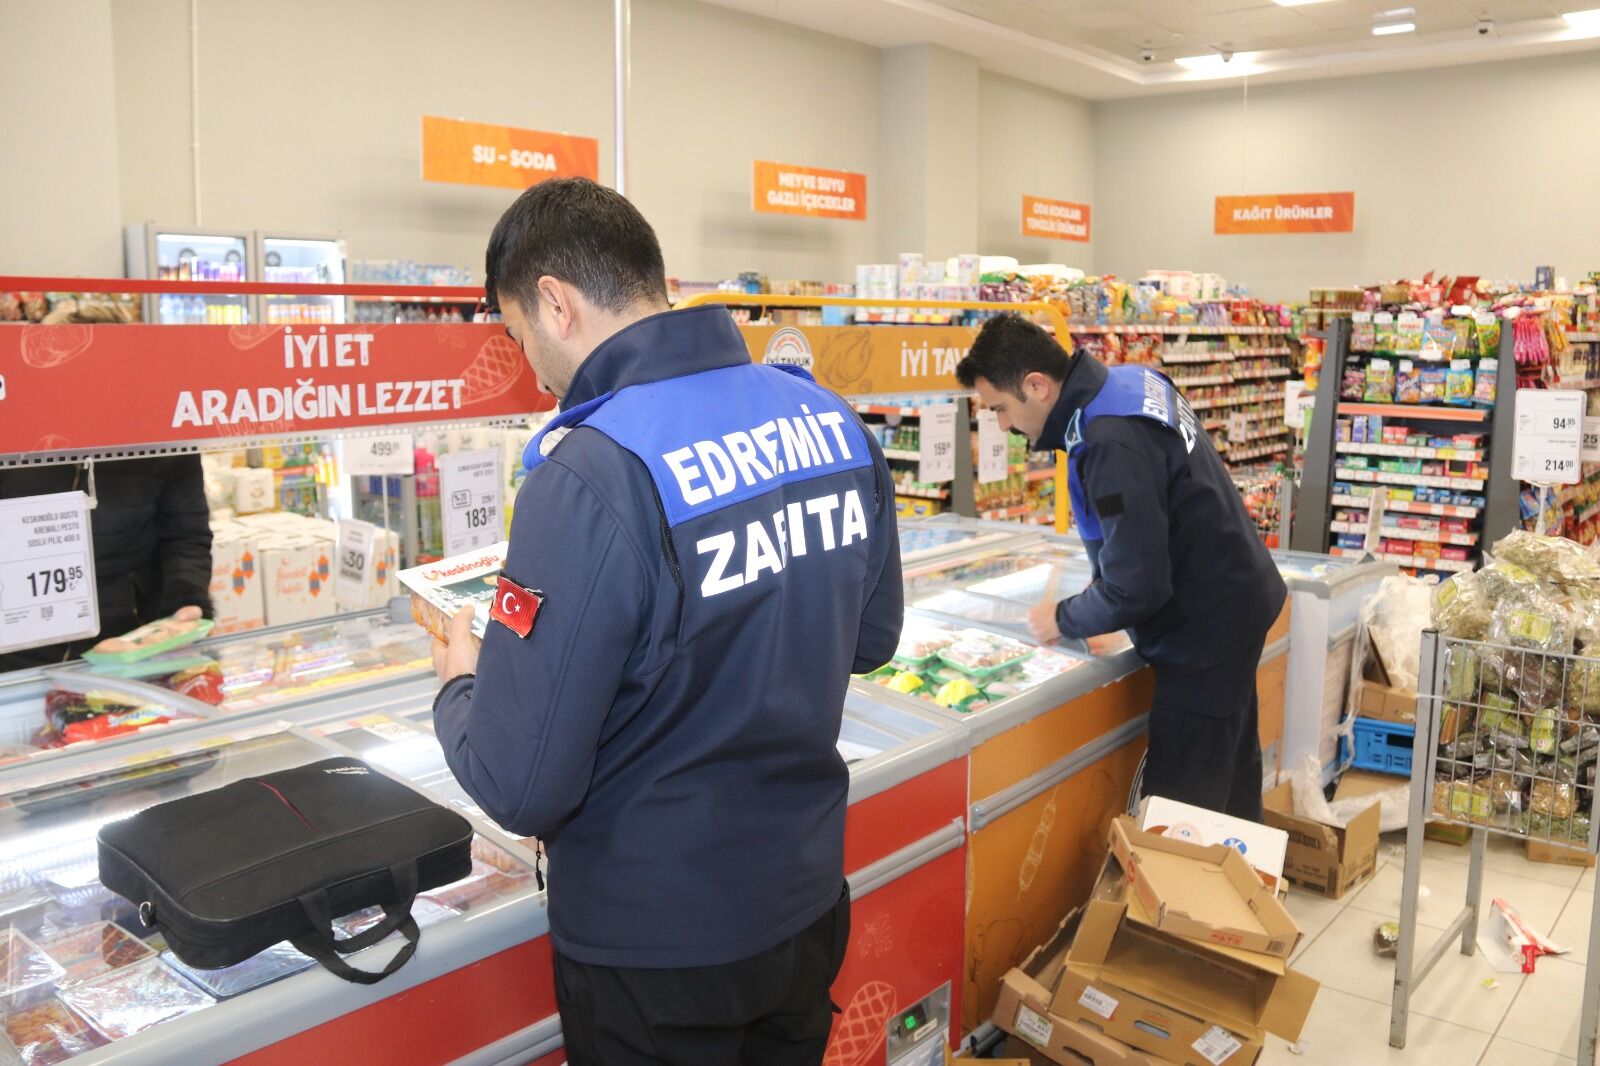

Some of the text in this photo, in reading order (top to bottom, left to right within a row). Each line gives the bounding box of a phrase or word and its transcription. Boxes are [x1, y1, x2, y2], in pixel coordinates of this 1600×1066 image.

[473, 144, 496, 165] SU
[510, 148, 557, 172] SODA
[779, 172, 846, 193] MEYVE SUYU
[767, 188, 856, 212] GAZLI İÇECEKLER
[1233, 203, 1333, 220] KAĞIT ÜRÜNLER
[284, 326, 374, 368] İYİ ET
[901, 341, 928, 377] İYİ
[172, 378, 465, 427] ARADIĞIN LEZZET
[662, 404, 853, 506] EDREMİT
[61, 522, 79, 531] PESTO
[438, 554, 500, 578] keskinoğlu
